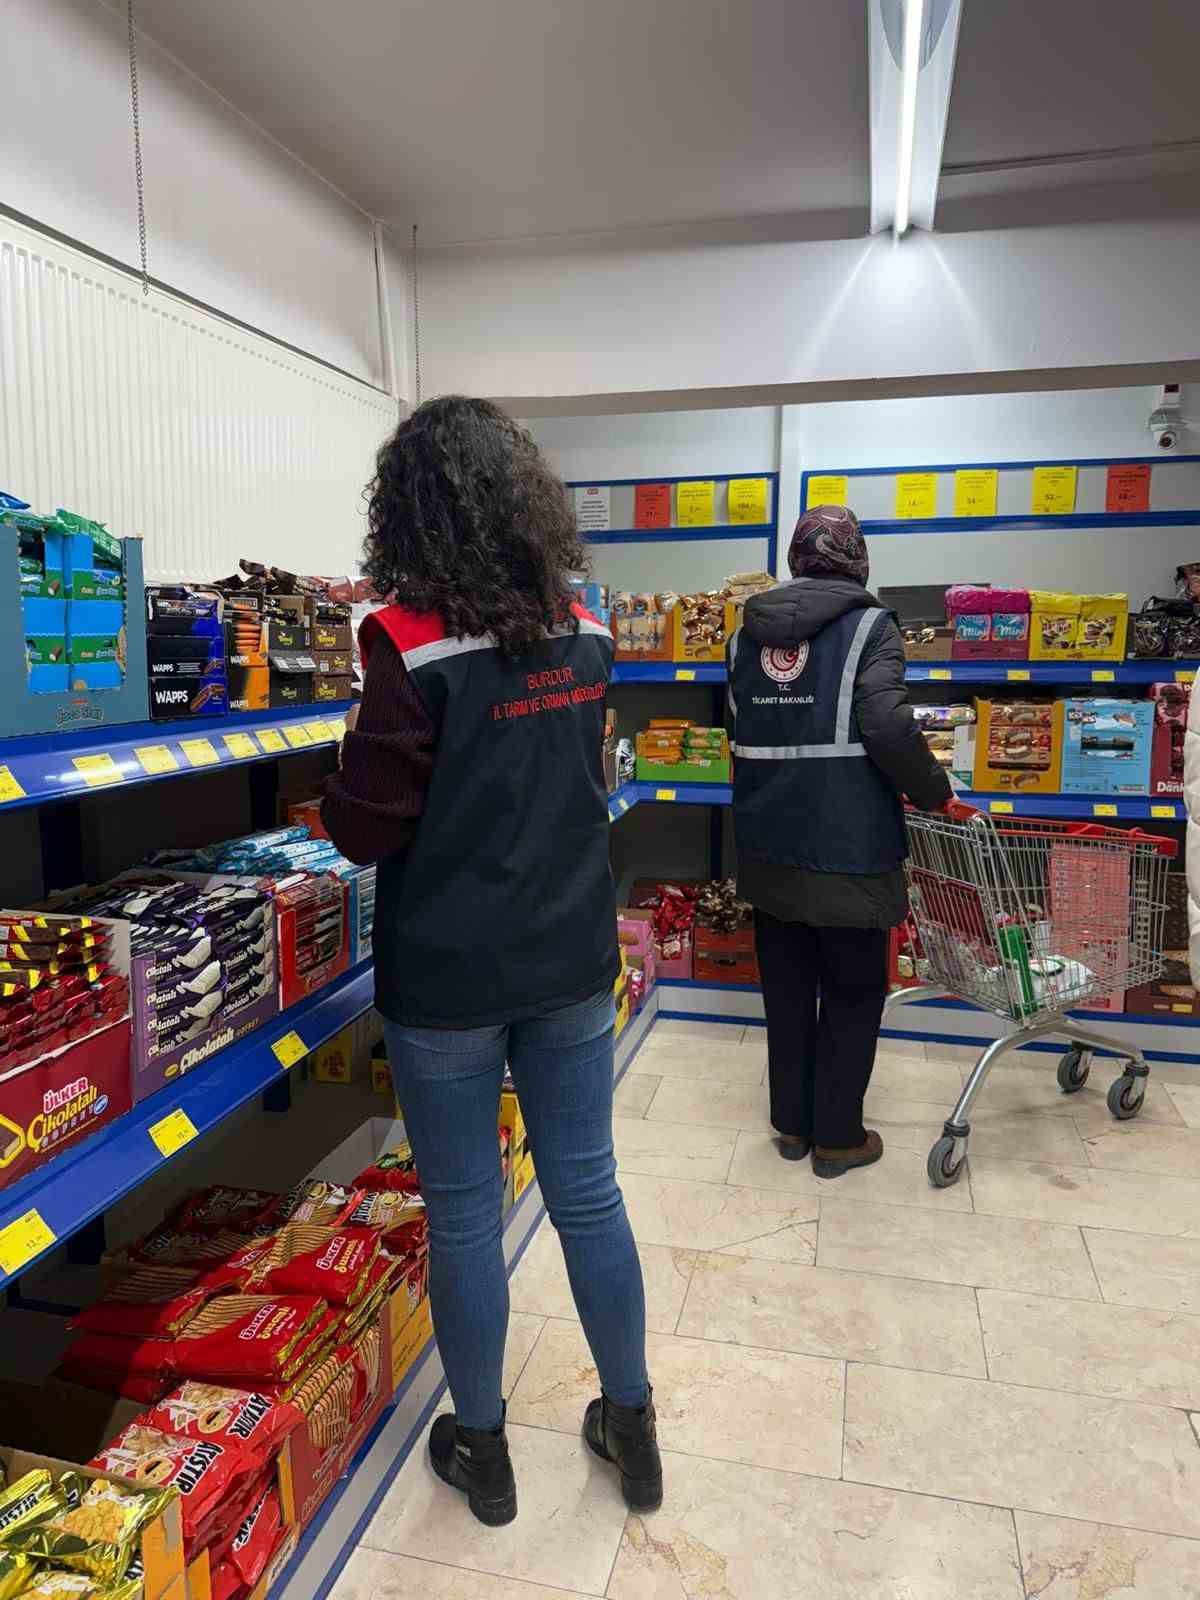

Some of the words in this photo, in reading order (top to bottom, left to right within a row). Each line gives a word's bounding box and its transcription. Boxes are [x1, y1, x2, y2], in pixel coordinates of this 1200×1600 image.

[152, 663, 174, 673] WAPPS
[230, 655, 250, 665] WAPPS
[527, 666, 575, 690] BURDUR
[155, 690, 189, 704] WAPPS
[752, 695, 778, 704] TİCARET
[43, 1078, 88, 1113] ÜLKER
[27, 1085, 97, 1153] Çikolatalı
[316, 1237, 346, 1270] ÜLKER
[239, 1304, 277, 1340] ÜLKER
[175, 1441, 223, 1495] ATIŞTIR
